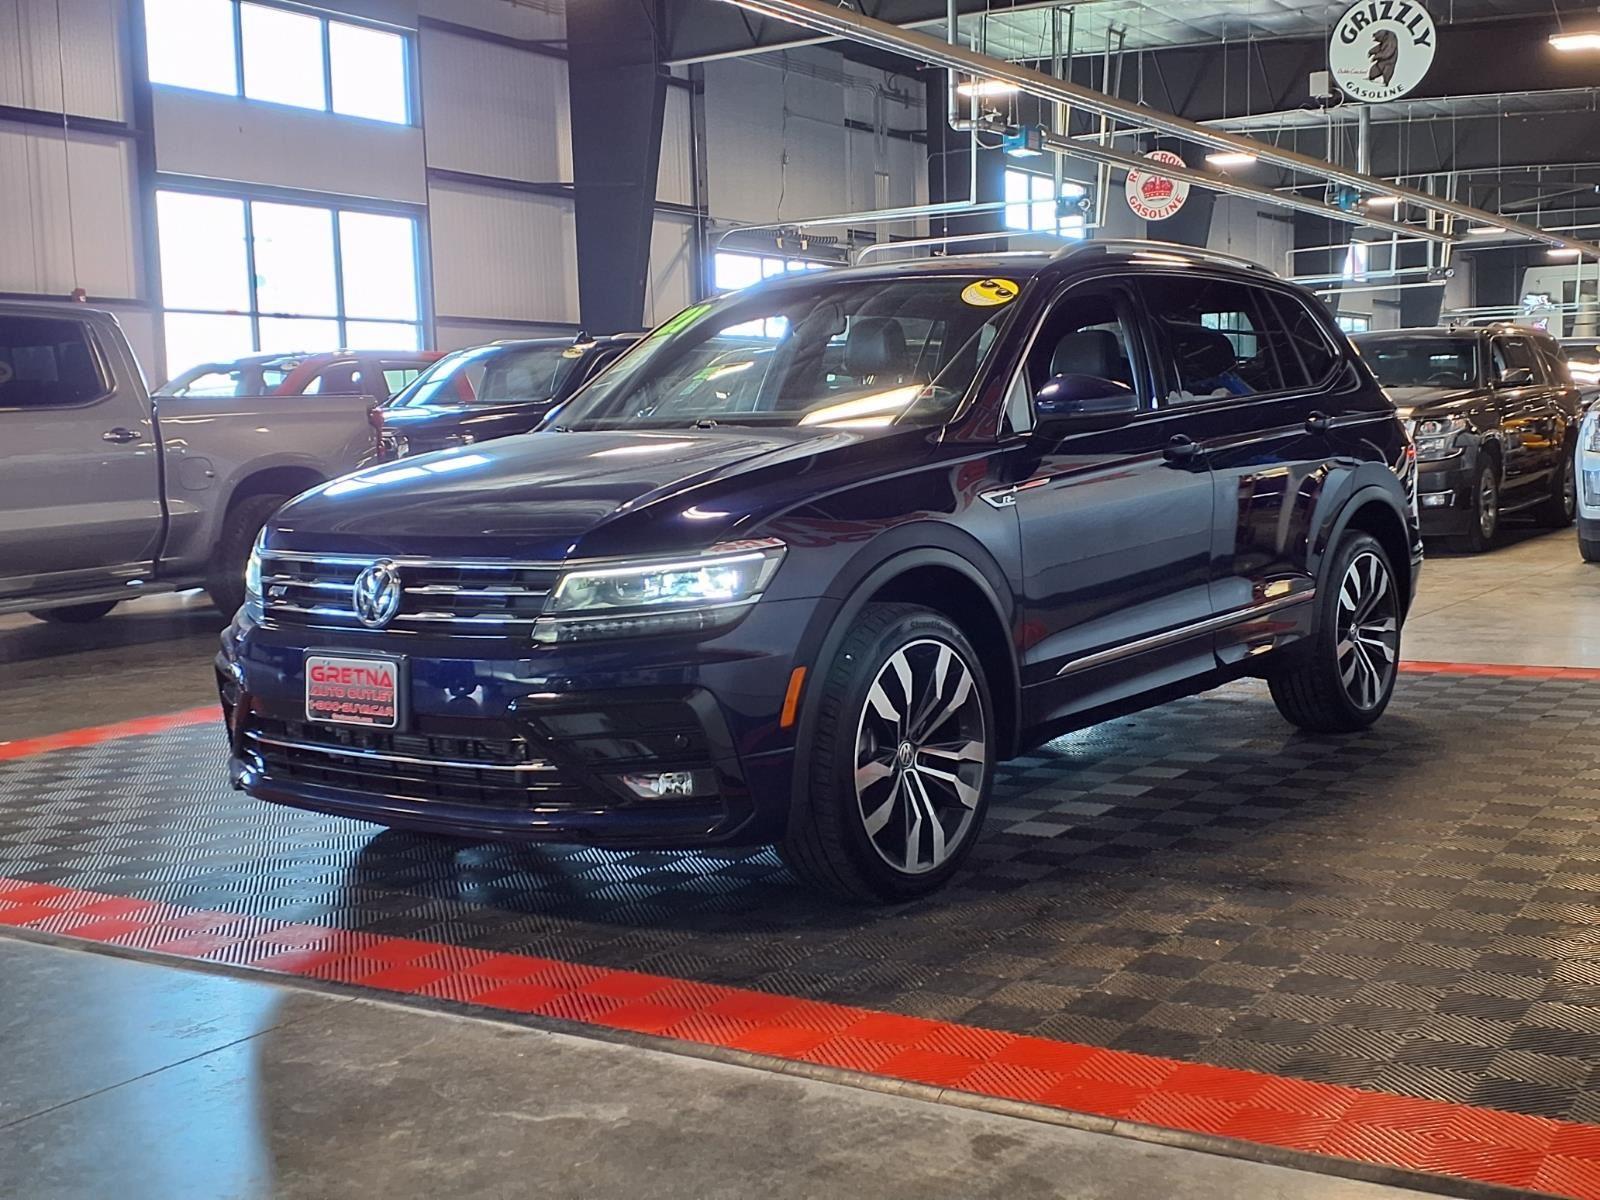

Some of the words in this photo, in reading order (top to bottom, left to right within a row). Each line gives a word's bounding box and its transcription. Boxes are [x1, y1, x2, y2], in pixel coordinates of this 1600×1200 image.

[1340, 1, 1431, 47] GRIZZLY
[1346, 81, 1404, 99] GASOLINE
[1129, 193, 1184, 218] GASOLINE
[310, 666, 393, 688] GRETNA
[310, 685, 345, 698] AUTO
[347, 688, 394, 703] OUTLET
